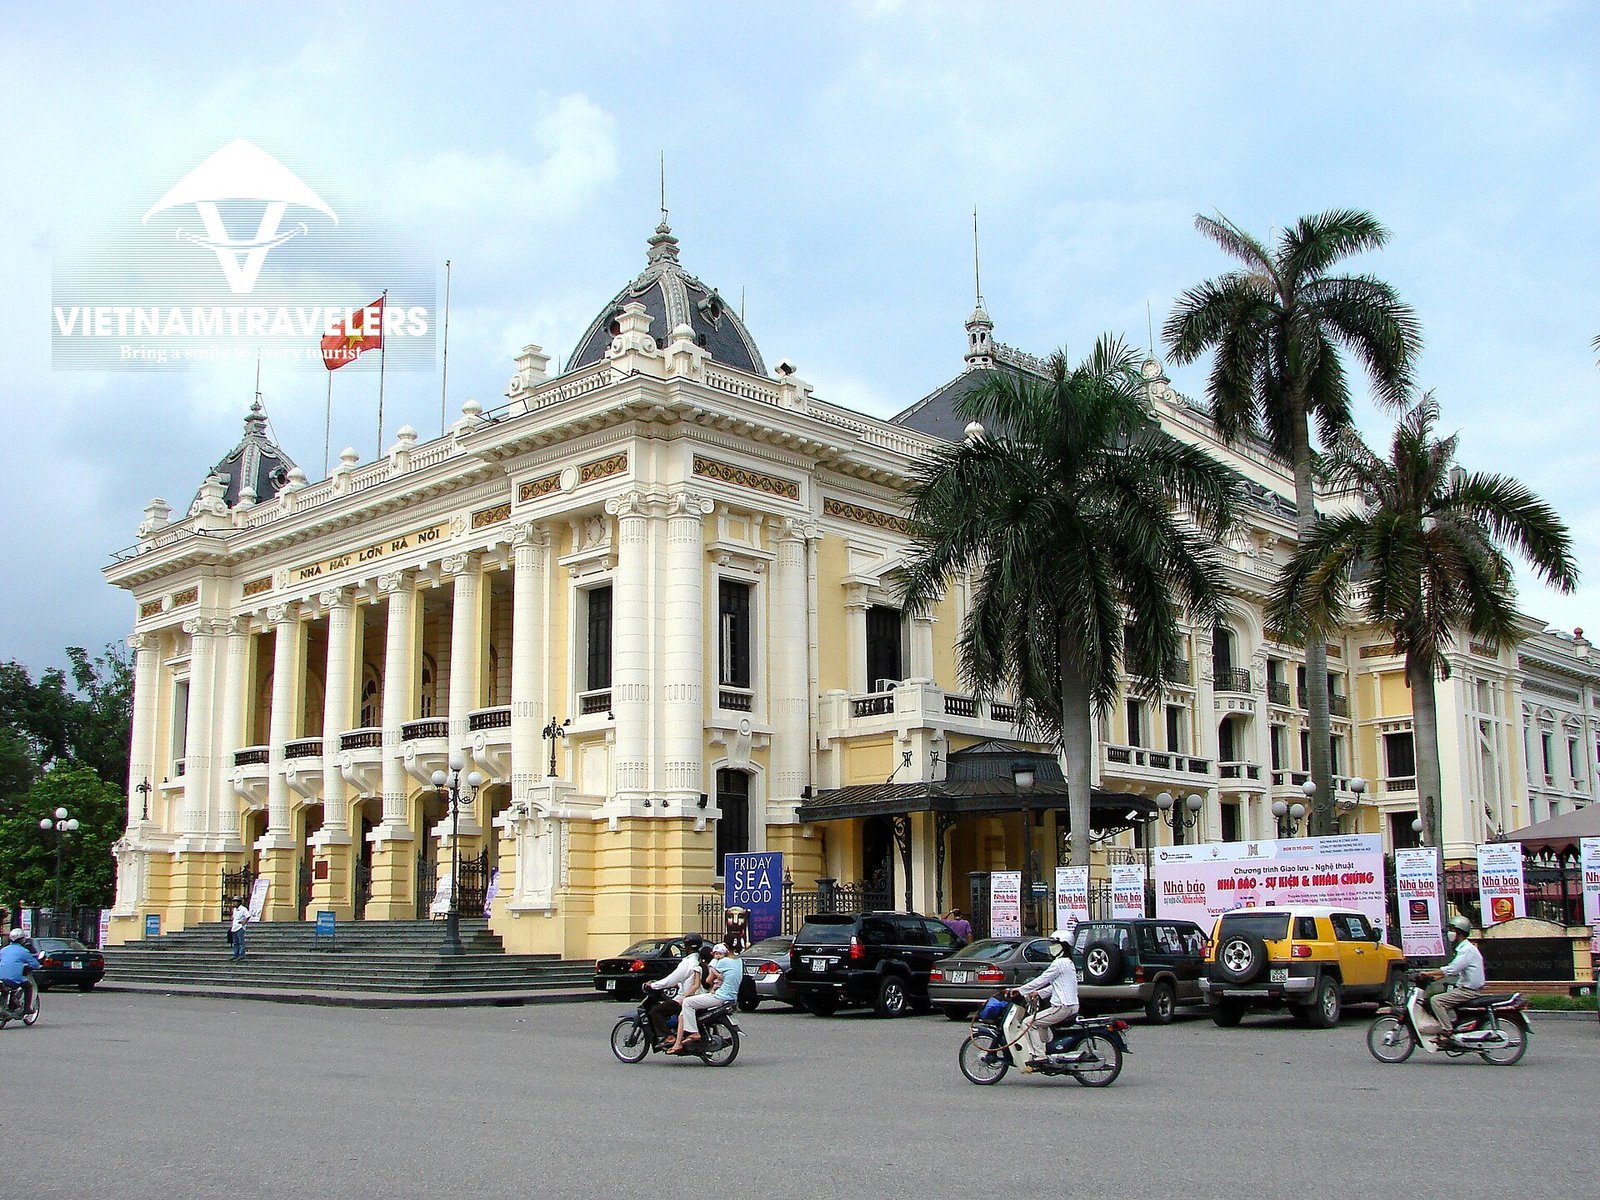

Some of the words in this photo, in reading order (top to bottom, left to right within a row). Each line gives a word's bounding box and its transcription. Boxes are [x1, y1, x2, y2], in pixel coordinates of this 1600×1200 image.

[734, 856, 772, 870] FRIDAY
[1233, 866, 1262, 877] Chương
[1280, 864, 1296, 873] Giao
[1315, 862, 1334, 873] Nghệ
[734, 870, 771, 890] SEA
[1217, 876, 1236, 890] NHÀ
[1301, 876, 1311, 886] &
[1399, 879, 1416, 889] Nhà
[1418, 878, 1434, 889] báo
[1482, 875, 1500, 886] Nhà
[1502, 874, 1519, 885] báo
[1585, 872, 1600, 882] Nh
[1163, 880, 1184, 893] Nhà
[1186, 879, 1205, 893] báo
[733, 890, 772, 903] FOOD
